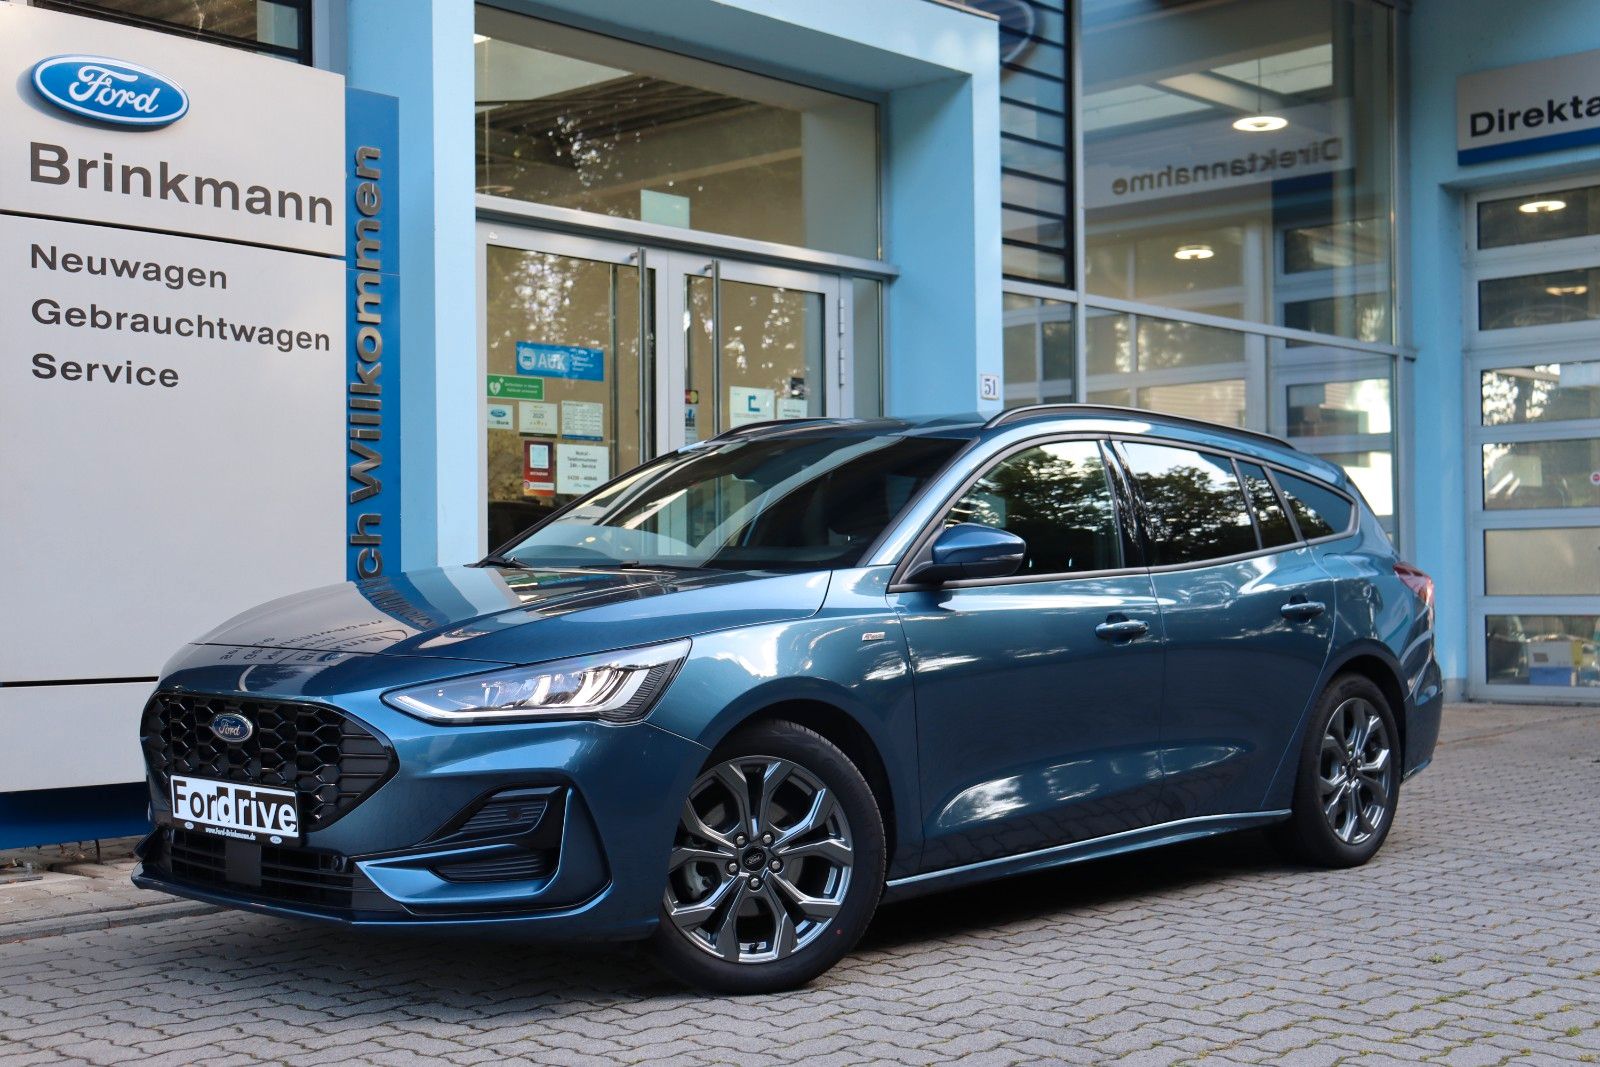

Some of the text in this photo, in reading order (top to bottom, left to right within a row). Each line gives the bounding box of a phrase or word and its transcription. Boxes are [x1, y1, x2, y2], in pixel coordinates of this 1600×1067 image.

[69, 65, 161, 114] Ford
[29, 141, 334, 227] Brinkmann
[30, 243, 228, 290] Neuwagen
[31, 298, 331, 353] Gebrauchtwagen
[349, 145, 383, 503] Willkommen
[31, 352, 180, 388] Service
[984, 378, 996, 396] 51
[218, 719, 241, 736] Ford
[172, 779, 297, 833] Fordrive
